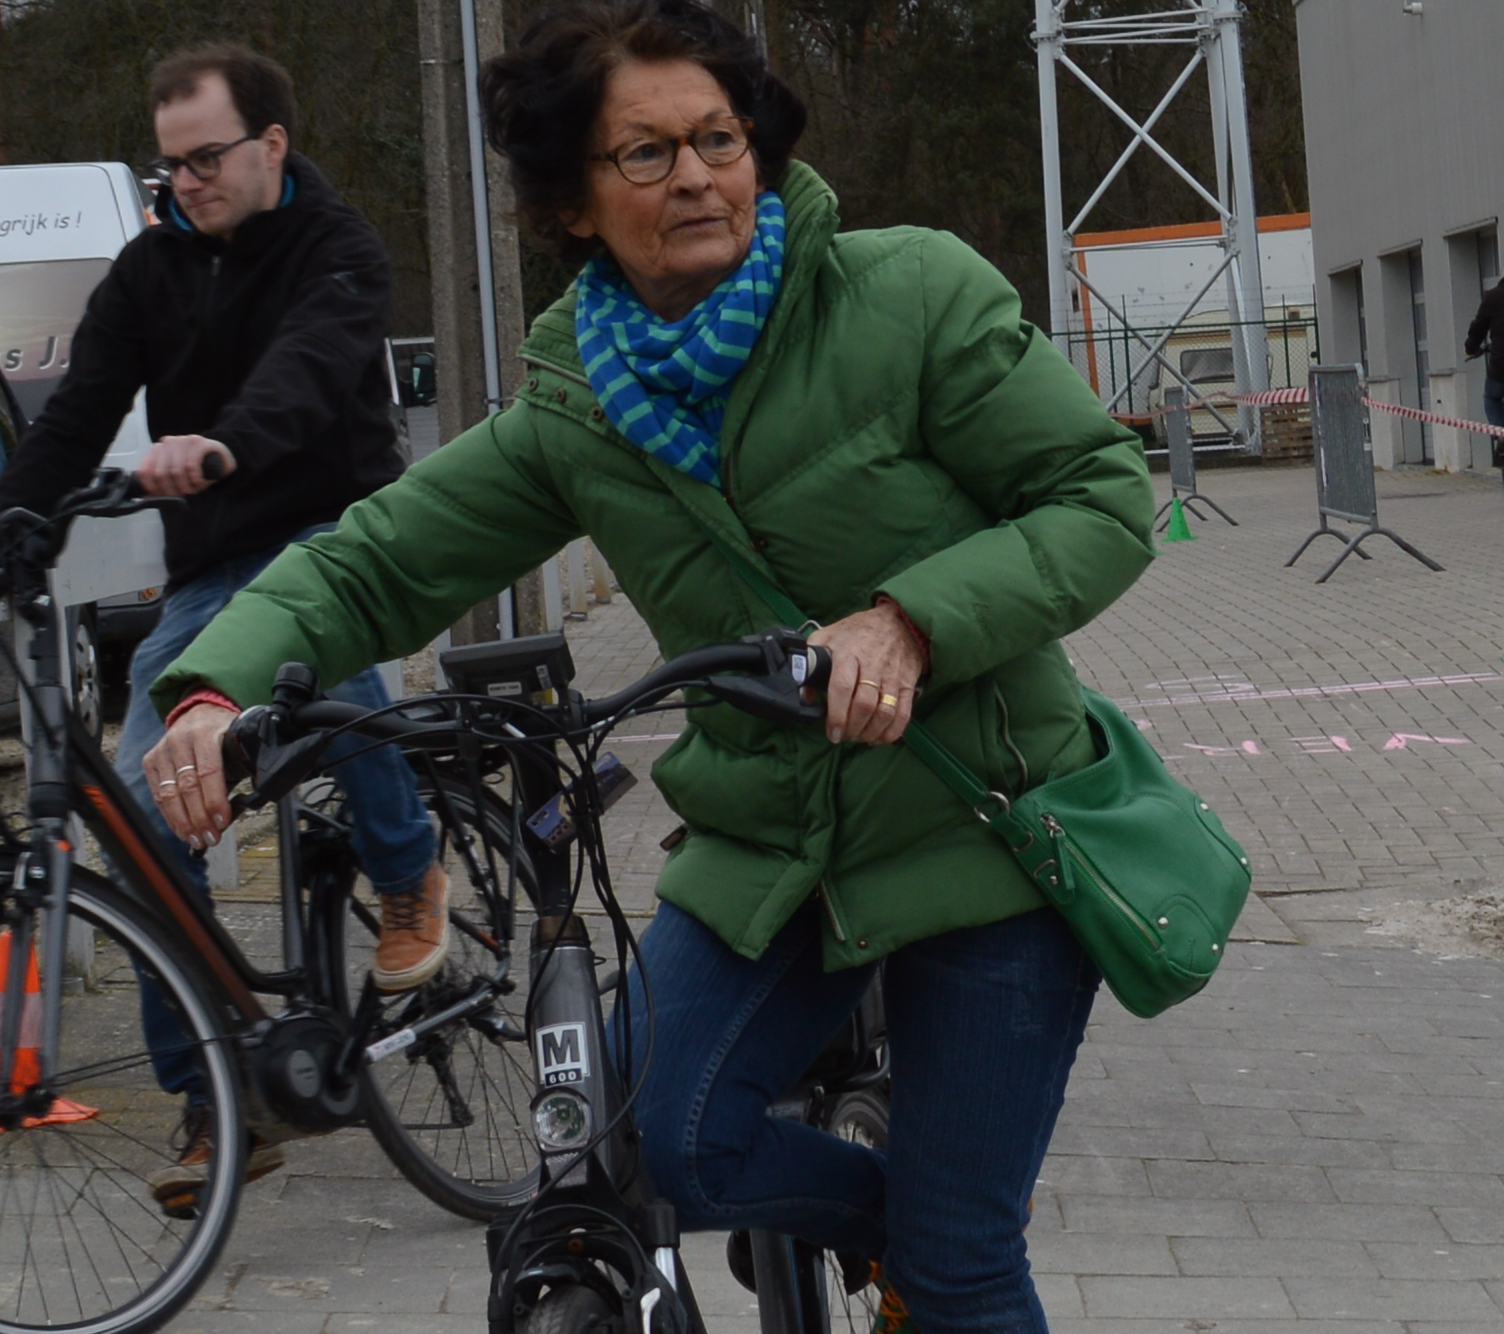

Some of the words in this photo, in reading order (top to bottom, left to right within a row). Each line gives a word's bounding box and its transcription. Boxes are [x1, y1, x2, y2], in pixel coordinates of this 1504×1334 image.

[54, 213, 70, 229] is
[542, 1029, 580, 1068] M
[549, 1071, 577, 1083] 600
